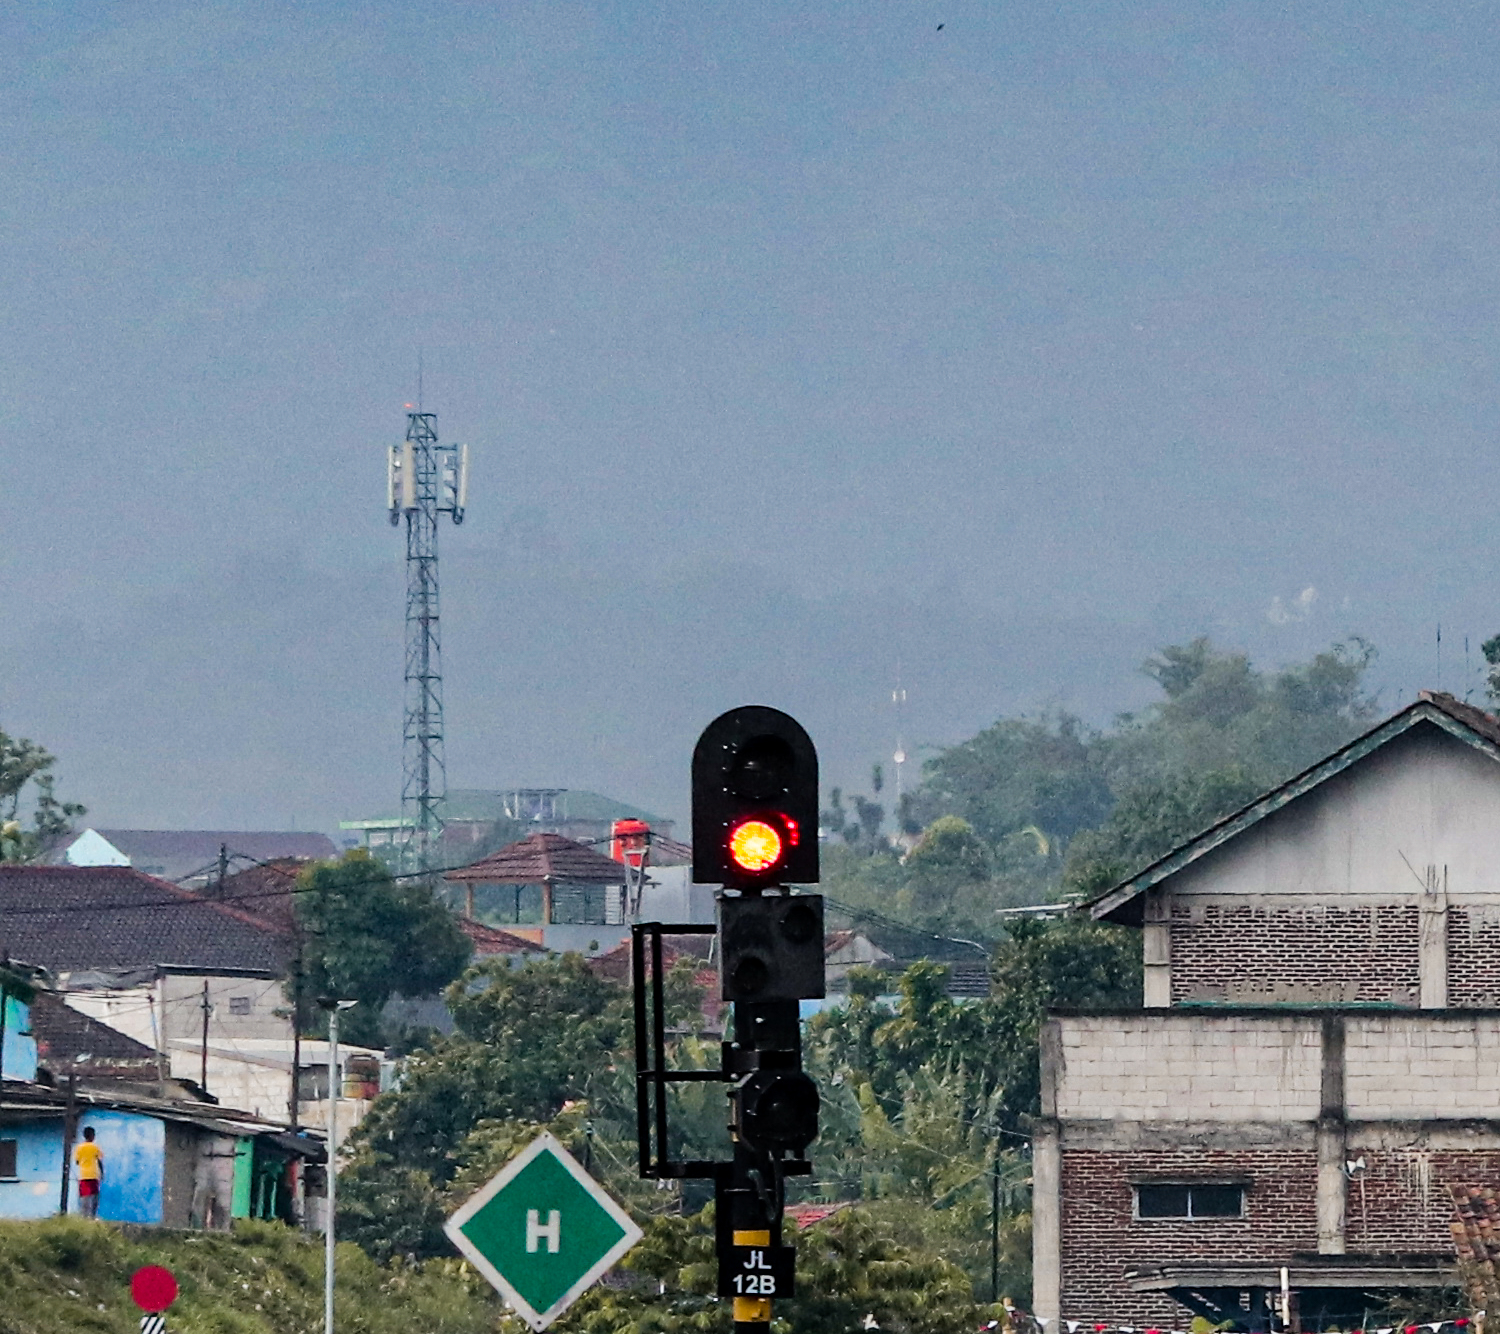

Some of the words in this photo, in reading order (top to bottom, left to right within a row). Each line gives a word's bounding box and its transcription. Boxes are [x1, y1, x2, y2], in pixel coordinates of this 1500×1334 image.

[526, 1209, 560, 1253] H
[743, 1251, 772, 1269] JL
[732, 1274, 776, 1294] 12B
